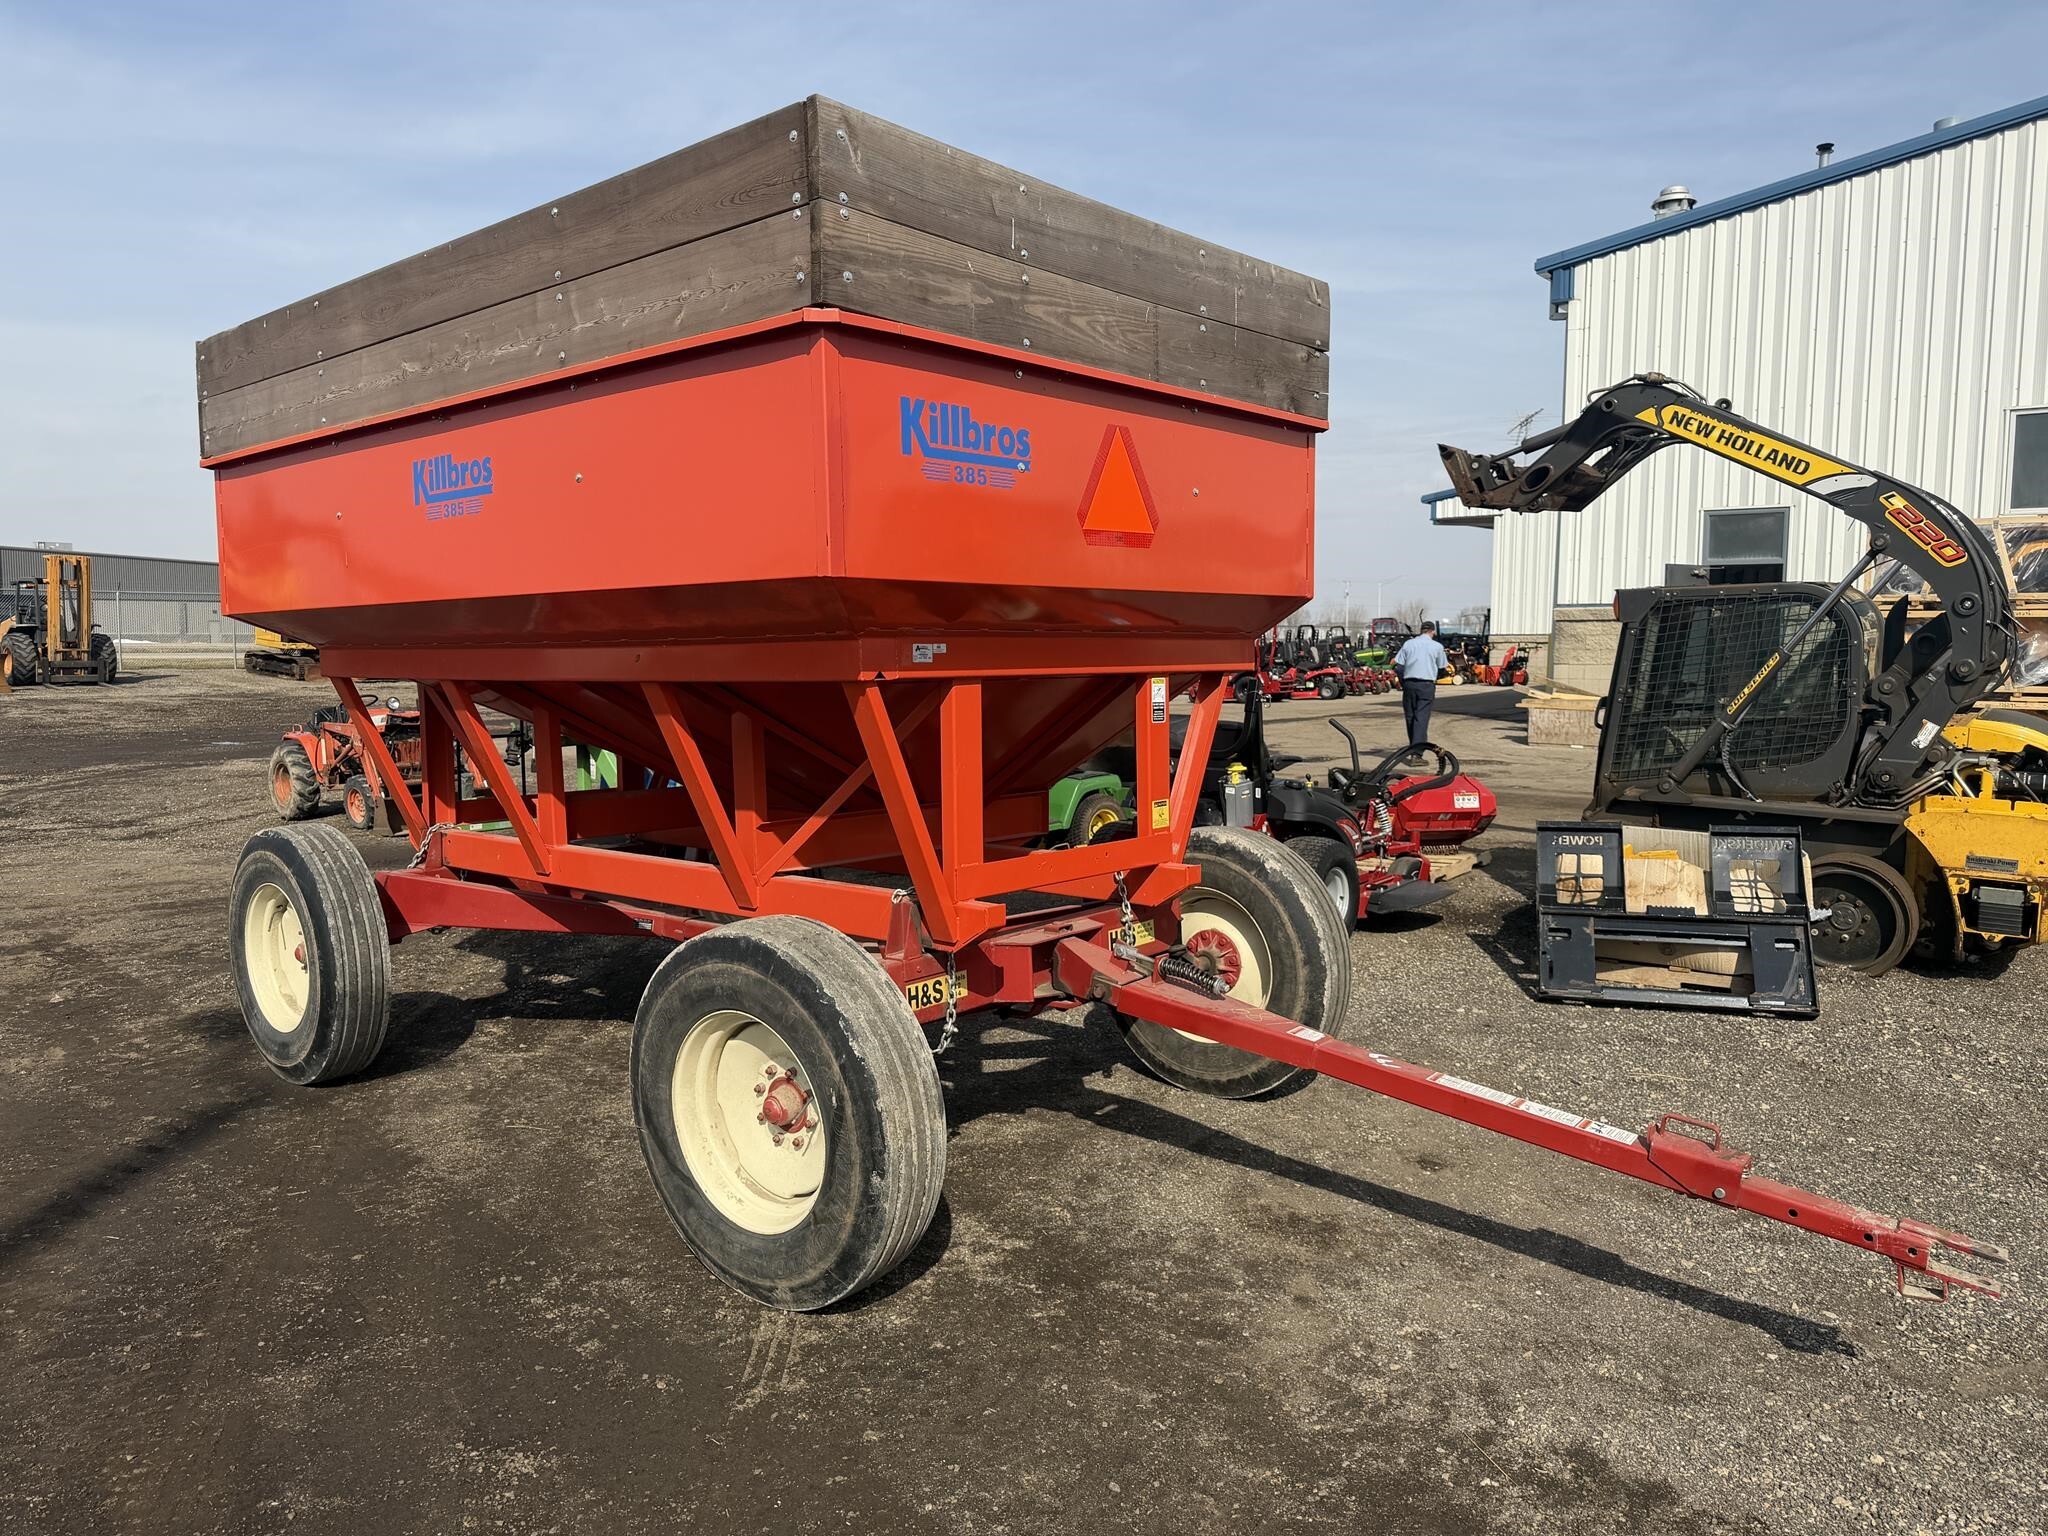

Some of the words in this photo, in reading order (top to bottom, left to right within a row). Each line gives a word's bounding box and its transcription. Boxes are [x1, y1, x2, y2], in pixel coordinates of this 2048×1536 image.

[900, 396, 1031, 460] Killbros
[1669, 410, 1716, 438] NEW
[1716, 428, 1811, 476] HOLLAND
[413, 454, 493, 506] Killbros
[953, 465, 988, 486] 385
[443, 501, 465, 518] 385
[1882, 493, 1967, 564] L220
[908, 979, 944, 1009] H&S
